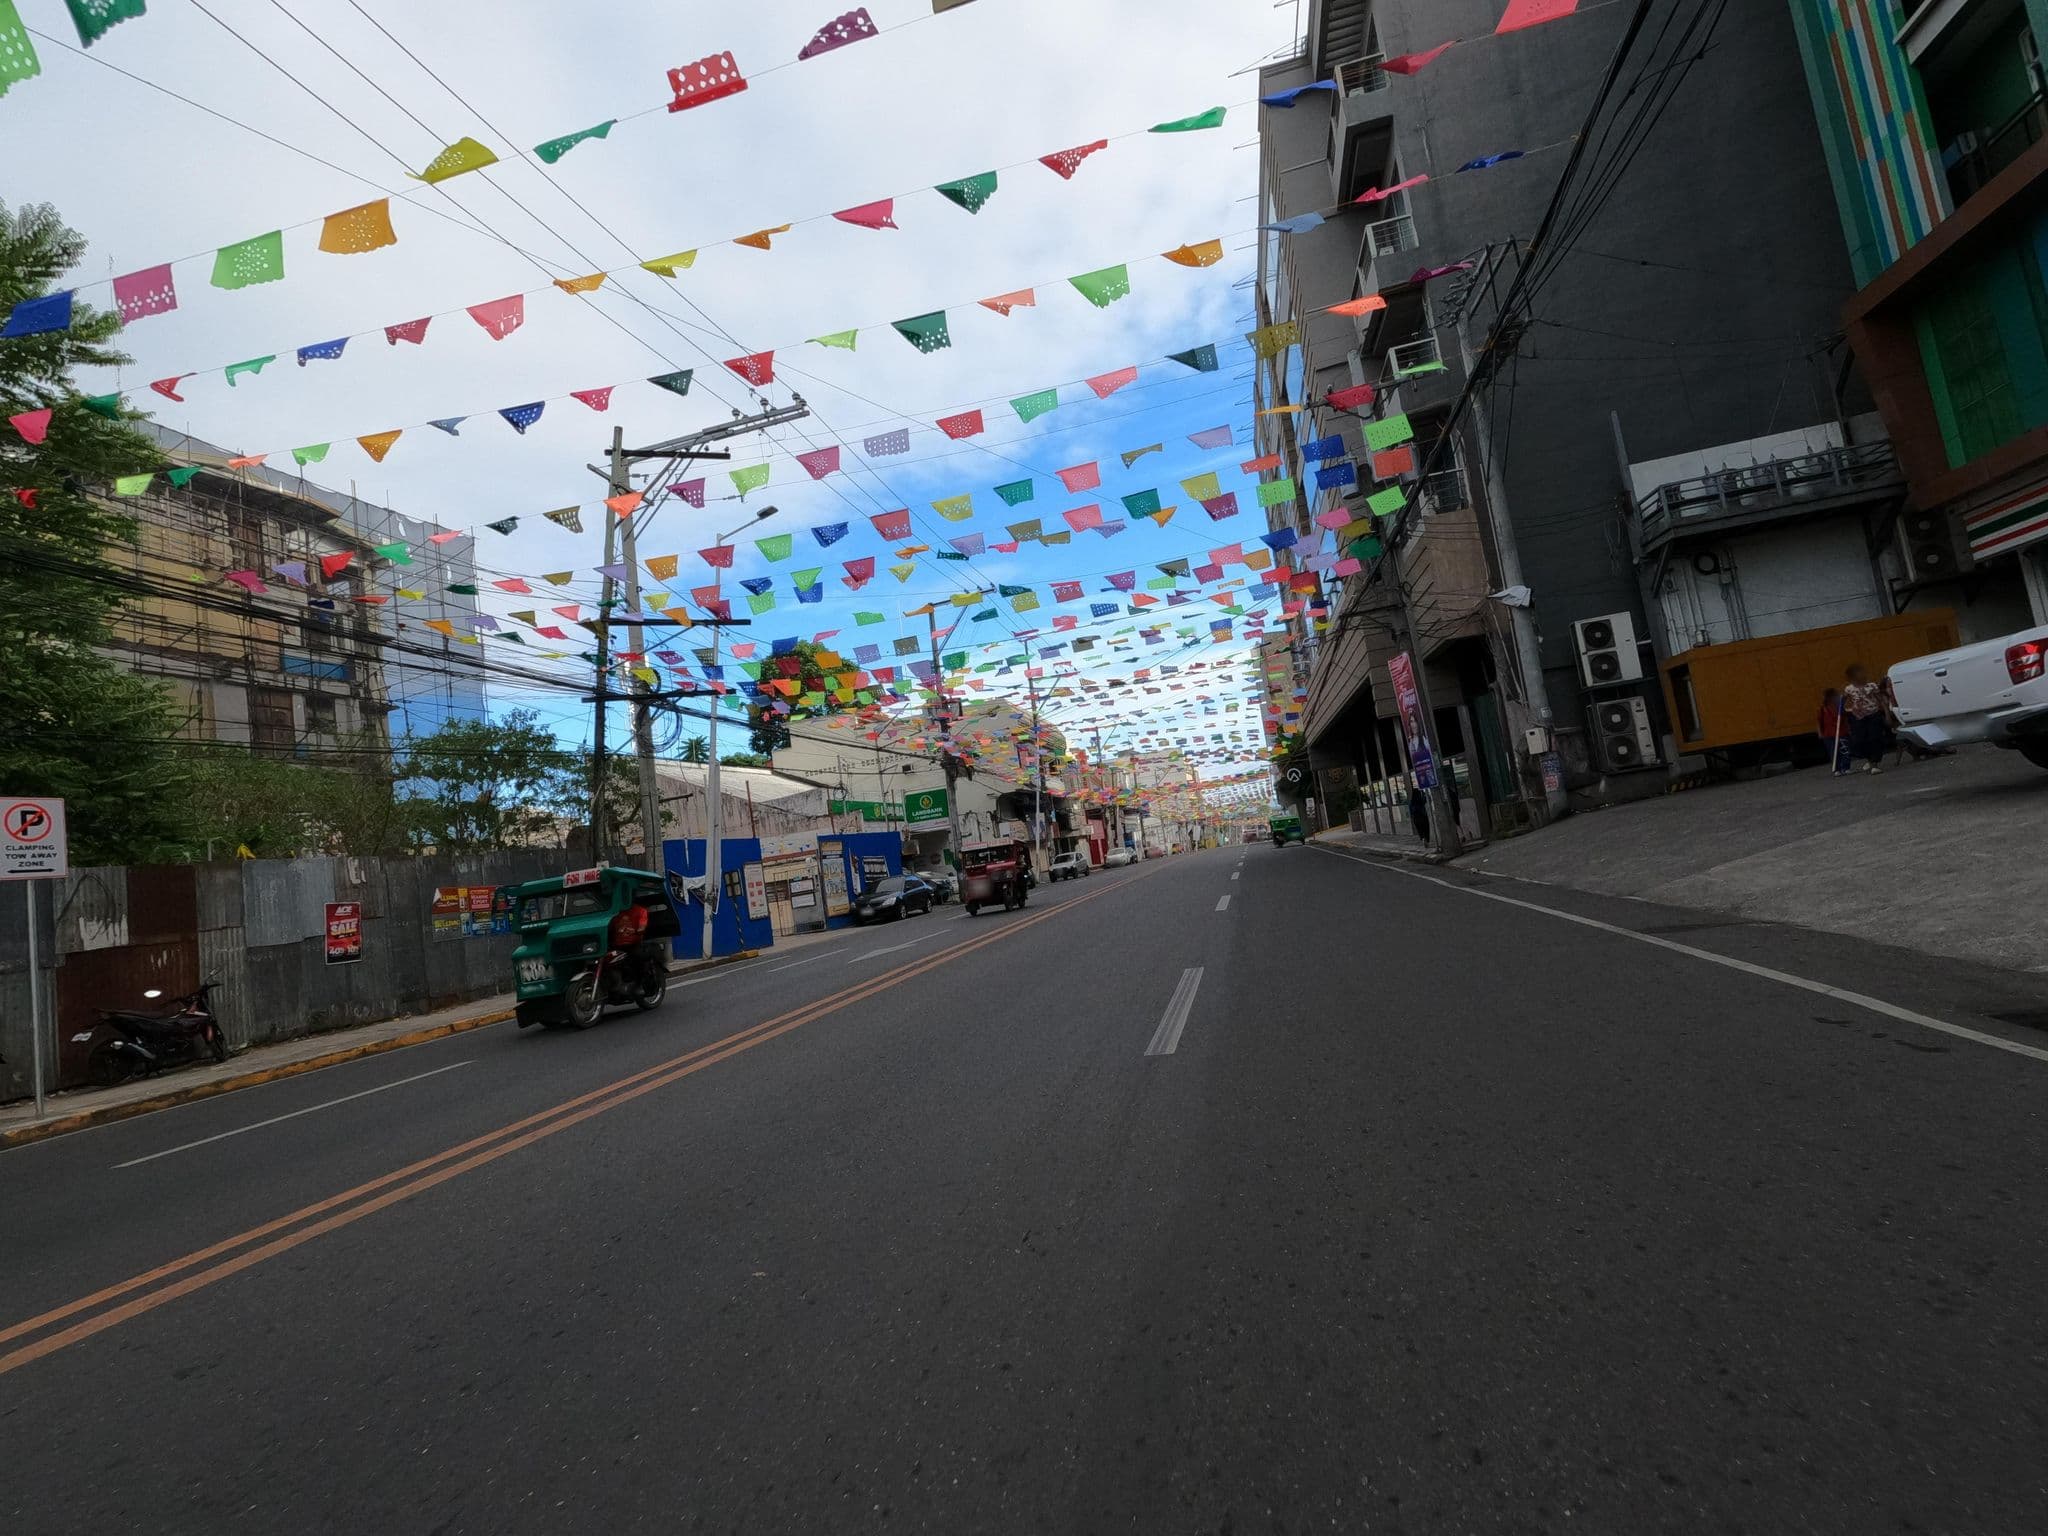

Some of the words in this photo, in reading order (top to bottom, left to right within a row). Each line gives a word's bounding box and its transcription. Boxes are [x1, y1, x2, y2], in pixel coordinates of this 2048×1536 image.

[911, 807, 944, 817] LANDBANK
[566, 873, 580, 884] FOR
[335, 905, 353, 914] ACE
[330, 919, 358, 936] SALE
